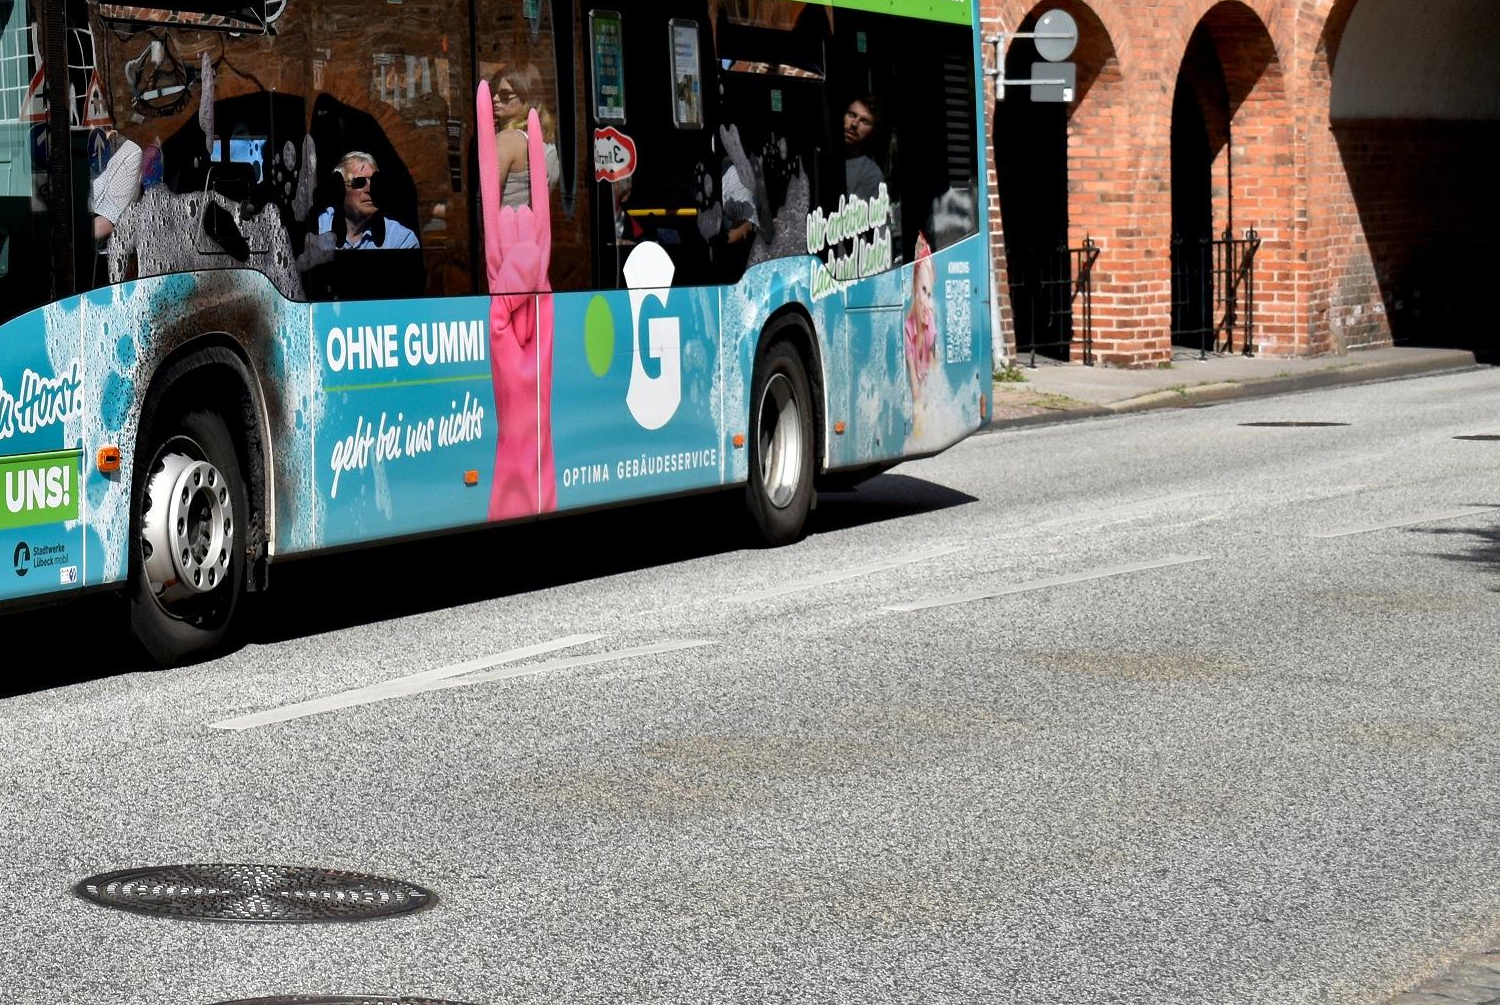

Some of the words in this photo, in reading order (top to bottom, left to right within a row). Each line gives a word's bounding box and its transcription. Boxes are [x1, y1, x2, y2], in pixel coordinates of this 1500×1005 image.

[326, 325, 398, 373] OHNE
[404, 320, 485, 367] GUMMI
[331, 415, 374, 499] geht
[376, 412, 403, 462] bei
[405, 417, 434, 457] uns
[438, 391, 484, 447] nichts
[5, 465, 70, 513] UNS!
[563, 463, 610, 487] OPTIMA
[617, 448, 717, 479] GEBÄUDESERVICE
[33, 543, 65, 556] Stadtwerke
[34, 556, 54, 568] Lübeck
[54, 554, 69, 565] mobil
